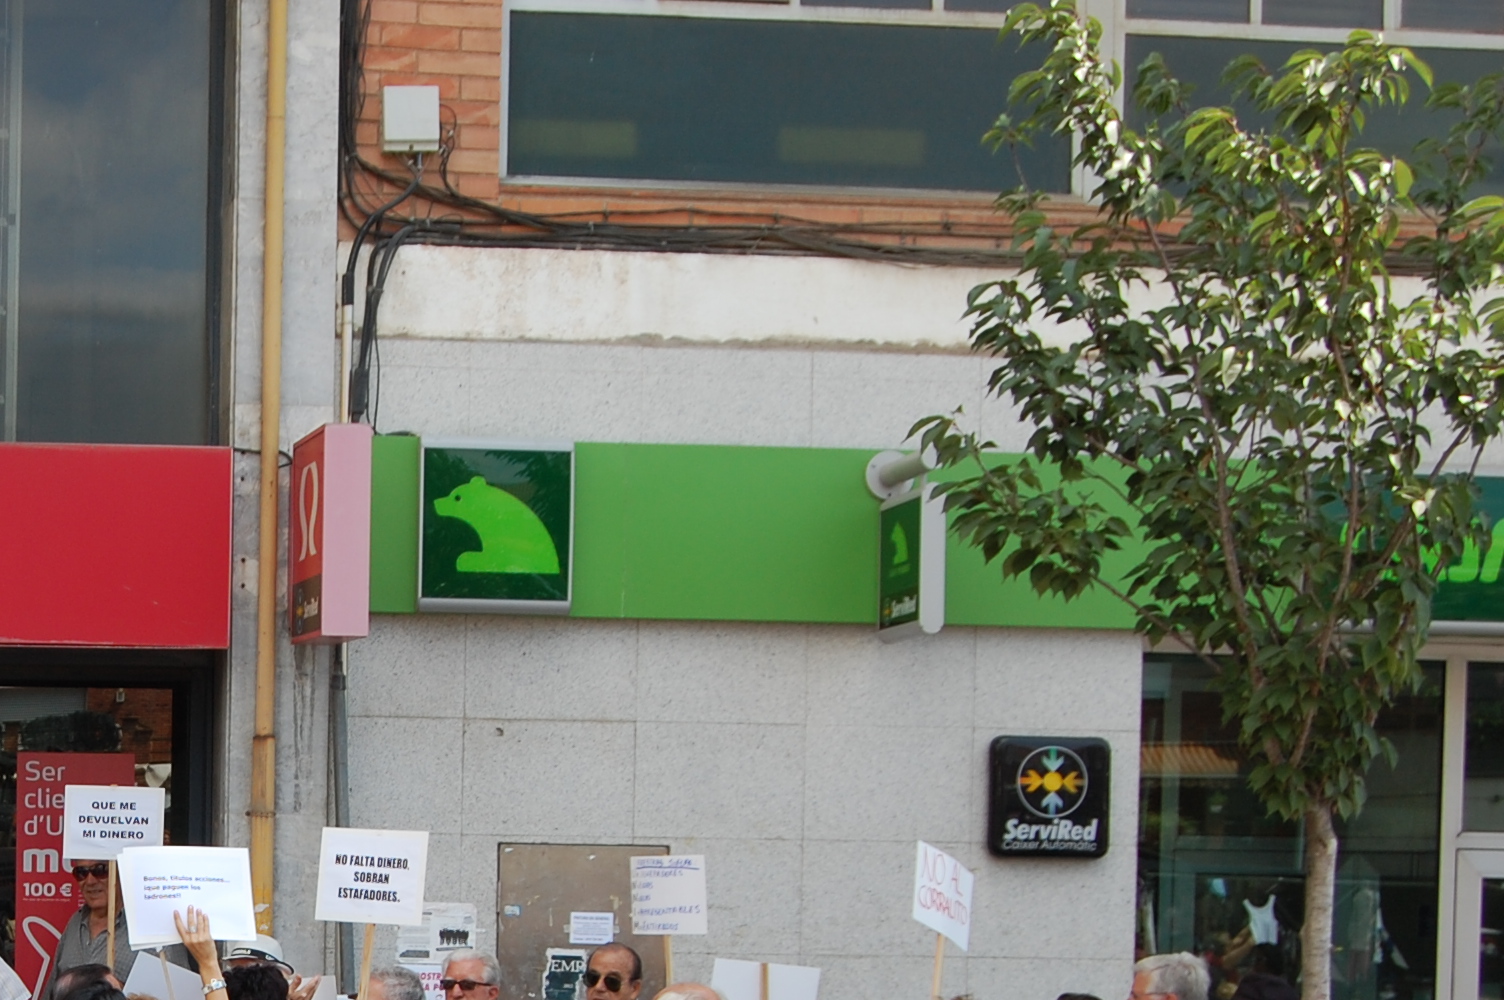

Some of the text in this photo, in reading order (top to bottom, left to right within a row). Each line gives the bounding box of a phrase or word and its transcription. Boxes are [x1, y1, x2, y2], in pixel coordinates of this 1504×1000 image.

[25, 760, 66, 782] Ser
[24, 787, 65, 809] clie
[91, 801, 137, 812] QUE ME
[78, 815, 149, 826] DEVUELVAN
[82, 830, 144, 840] MI DINERO
[1003, 817, 1099, 842] ServiRed
[335, 853, 348, 866] NO
[349, 855, 376, 868] FALTA
[921, 845, 946, 886] NO
[353, 871, 390, 885] SOBRAN
[23, 882, 73, 897] 100 €
